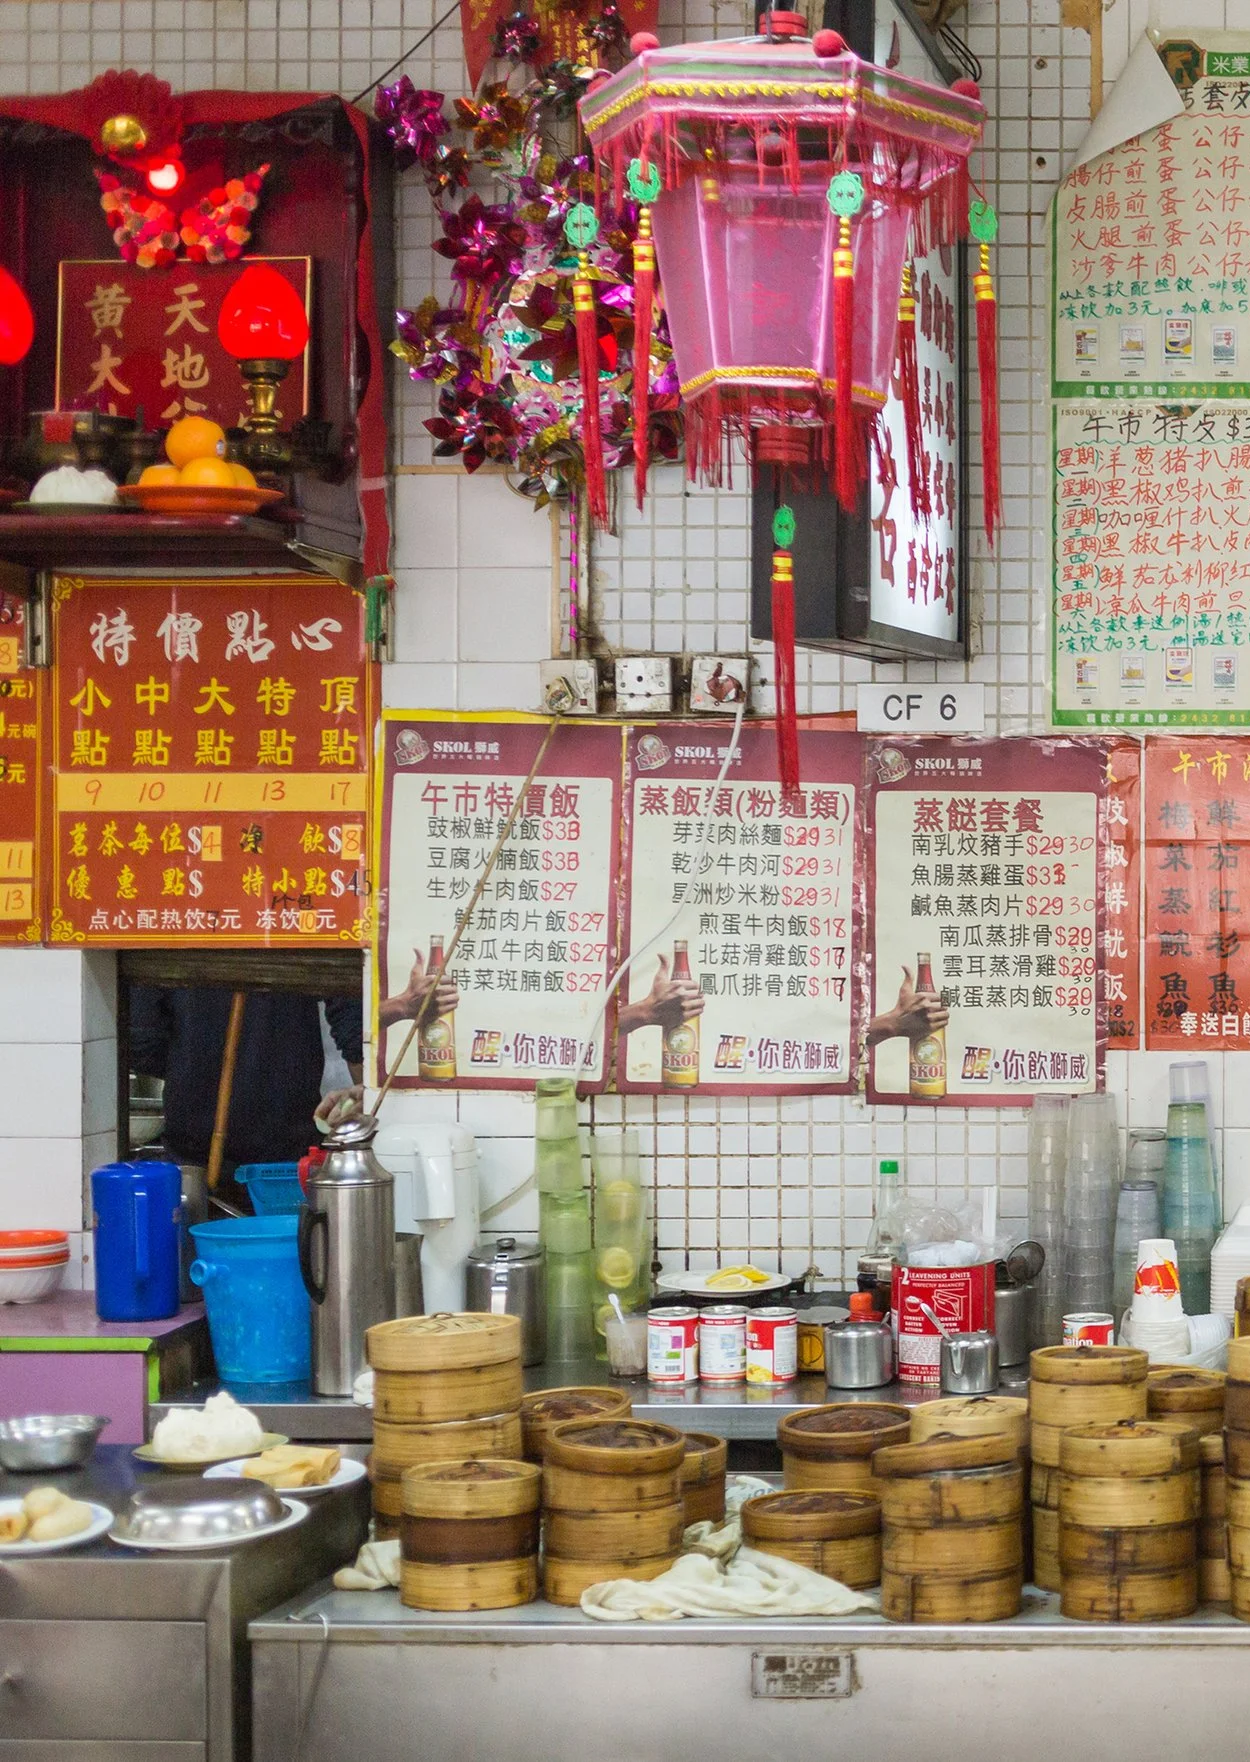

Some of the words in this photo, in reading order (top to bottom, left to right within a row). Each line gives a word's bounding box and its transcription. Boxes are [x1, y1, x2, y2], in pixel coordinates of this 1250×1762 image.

[1212, 56, 1249, 74] 米業
[89, 607, 344, 667] 特價點心
[883, 694, 923, 720] CF
[939, 694, 957, 720] 6
[433, 741, 472, 753] SKOL
[674, 746, 715, 759] SKOL
[915, 758, 954, 769] SKOL
[85, 779, 102, 804] 9
[138, 780, 165, 803] 10
[203, 781, 222, 803] 11
[262, 781, 286, 802] 13
[330, 780, 351, 805] 17
[421, 781, 580, 819] 午市特價飯
[913, 797, 1044, 833] 蒸餸套餐
